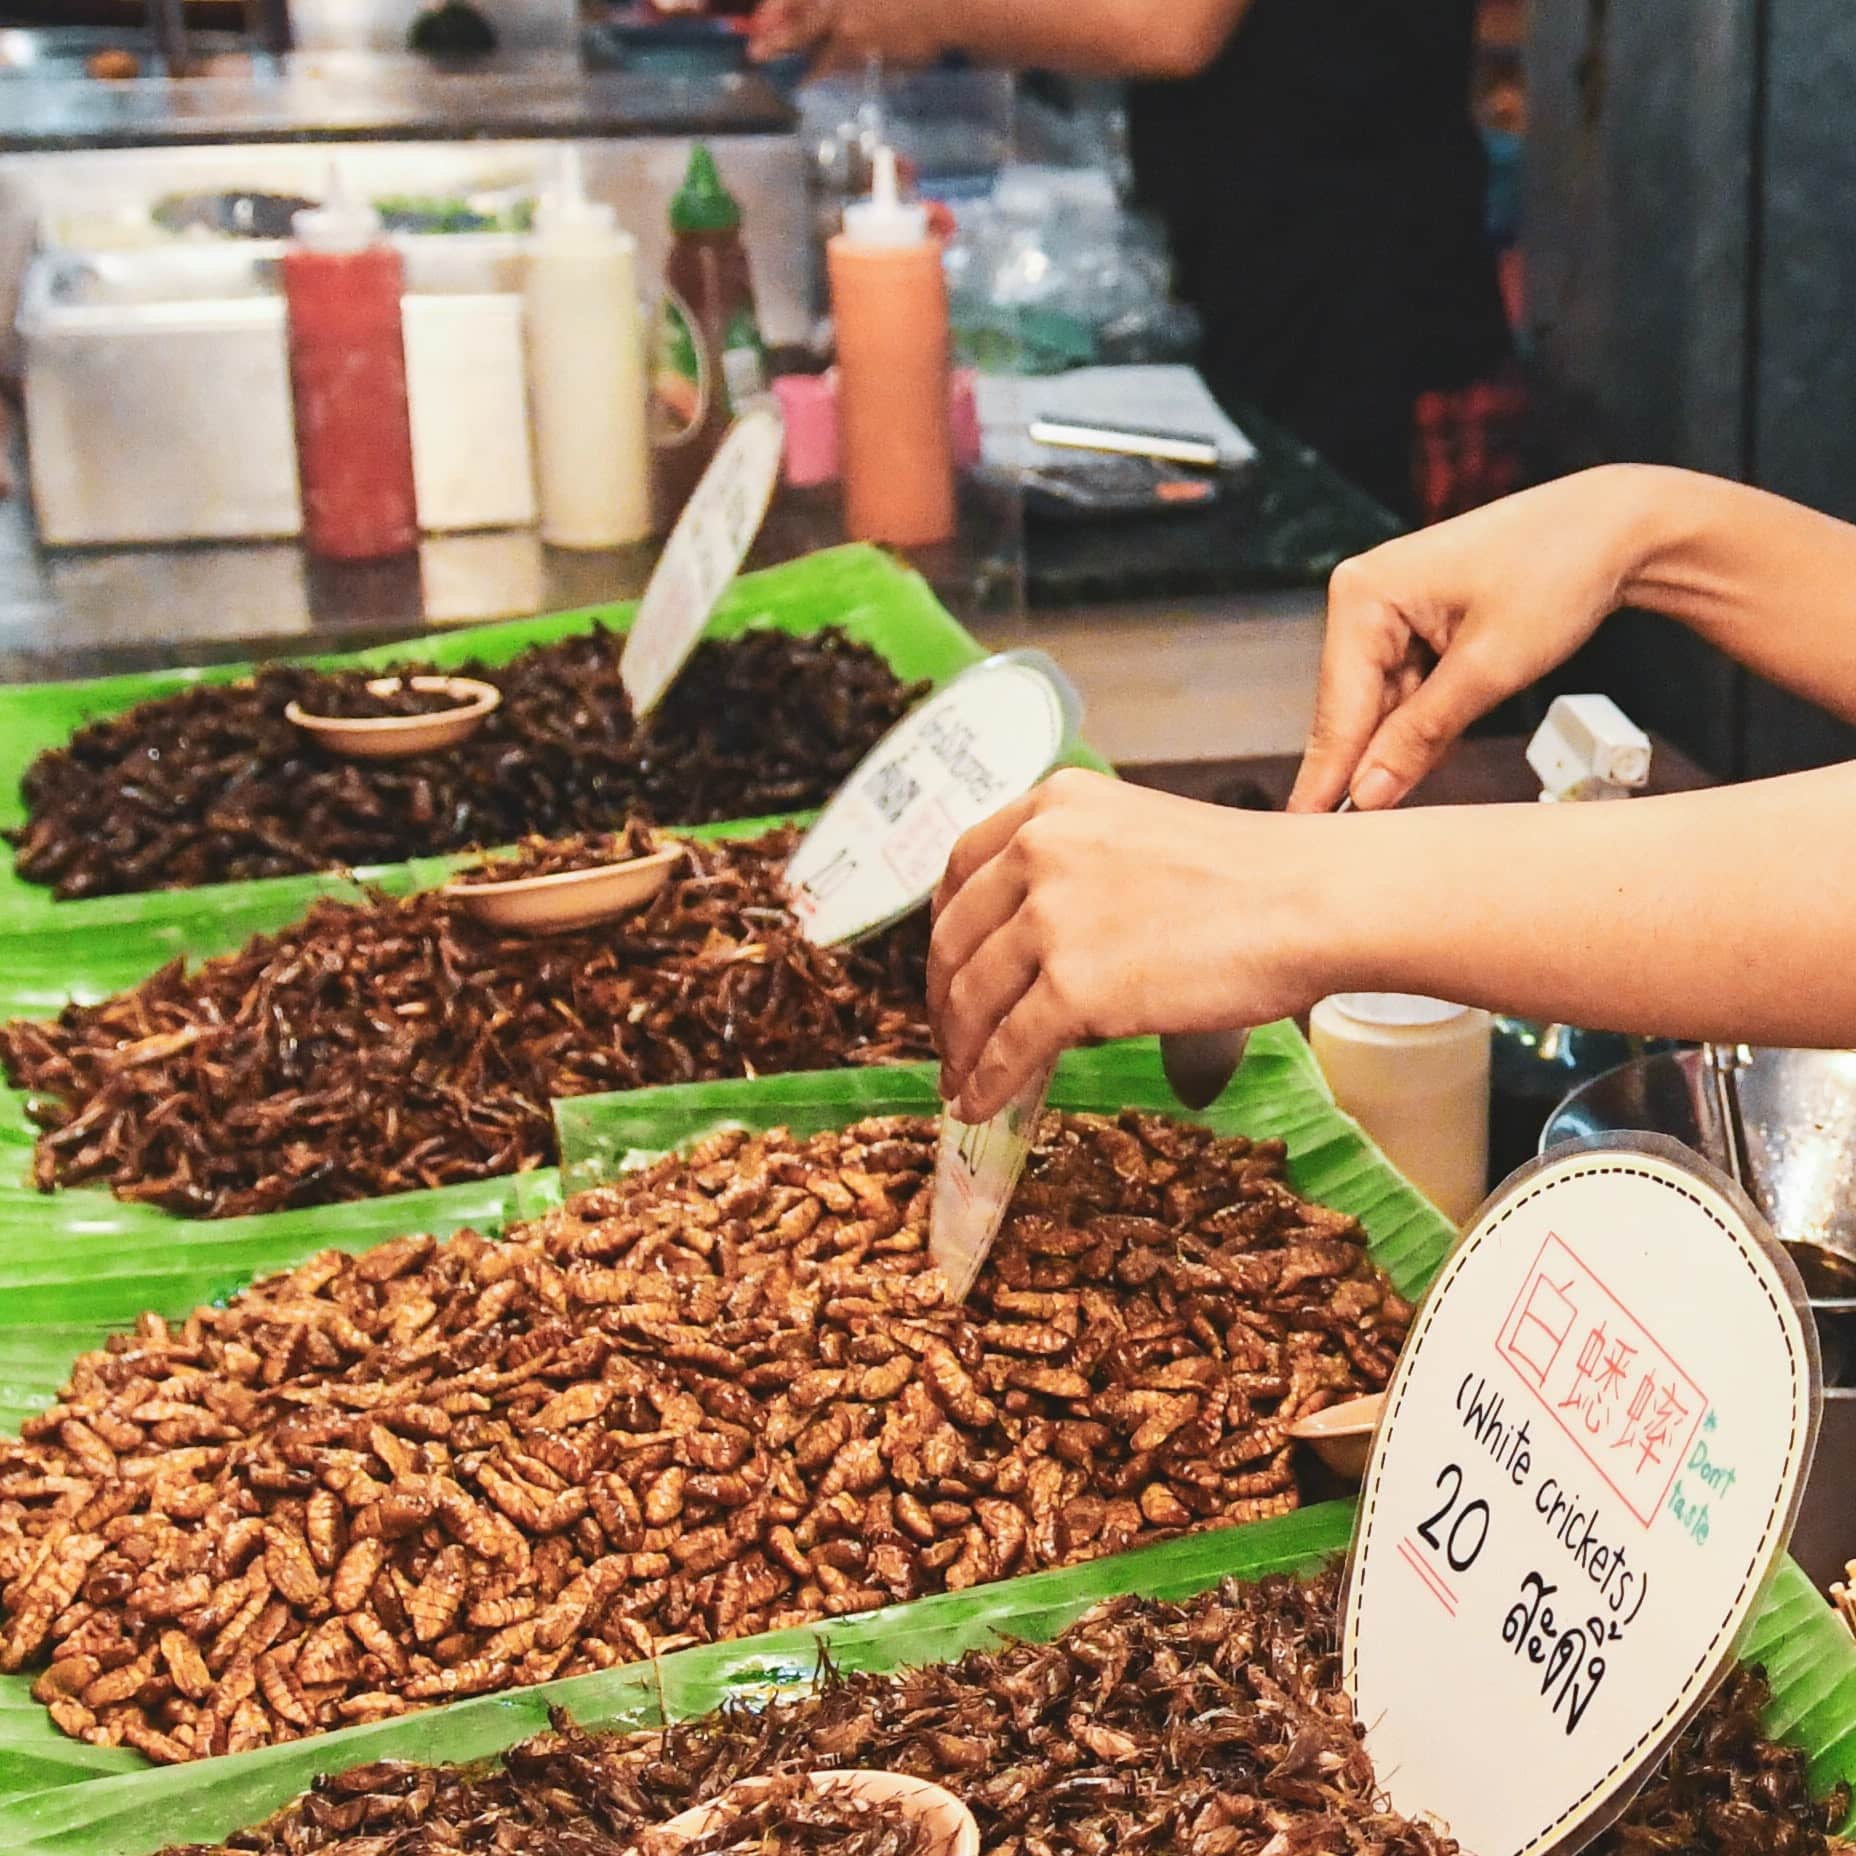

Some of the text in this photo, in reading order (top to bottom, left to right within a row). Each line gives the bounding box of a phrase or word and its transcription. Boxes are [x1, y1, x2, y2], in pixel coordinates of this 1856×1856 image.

[1416, 1463, 1491, 1573] 20
[1456, 1372, 1648, 1625] (White crickets)
[1667, 1479, 1710, 1546] taste
